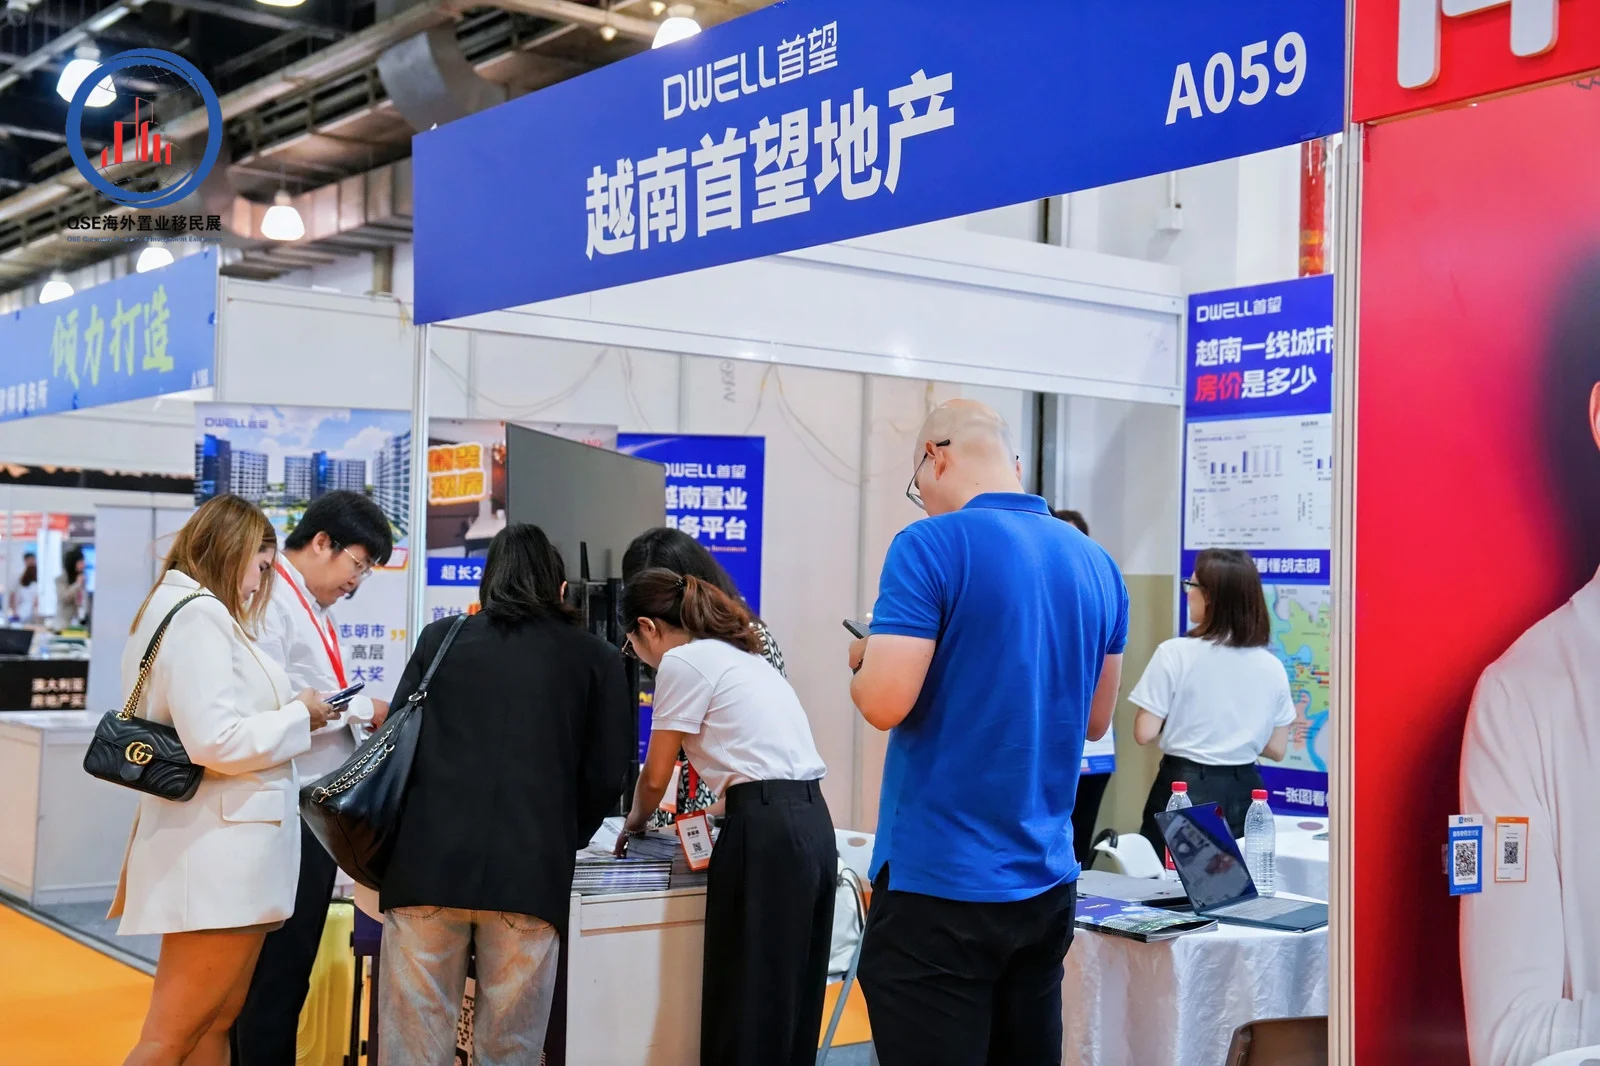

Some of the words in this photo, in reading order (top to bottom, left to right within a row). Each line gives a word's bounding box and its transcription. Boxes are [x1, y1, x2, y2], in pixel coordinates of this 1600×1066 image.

[1165, 31, 1307, 126] A059
[585, 68, 955, 261] 越南首望地产
[50, 284, 174, 389] 倾力打造
[1194, 364, 1317, 403] 房价是多少
[1252, 557, 1321, 574] 看懂胡志明
[352, 644, 385, 660] 高层
[351, 665, 385, 682] 大奖
[1273, 787, 1329, 807] 一张图看
